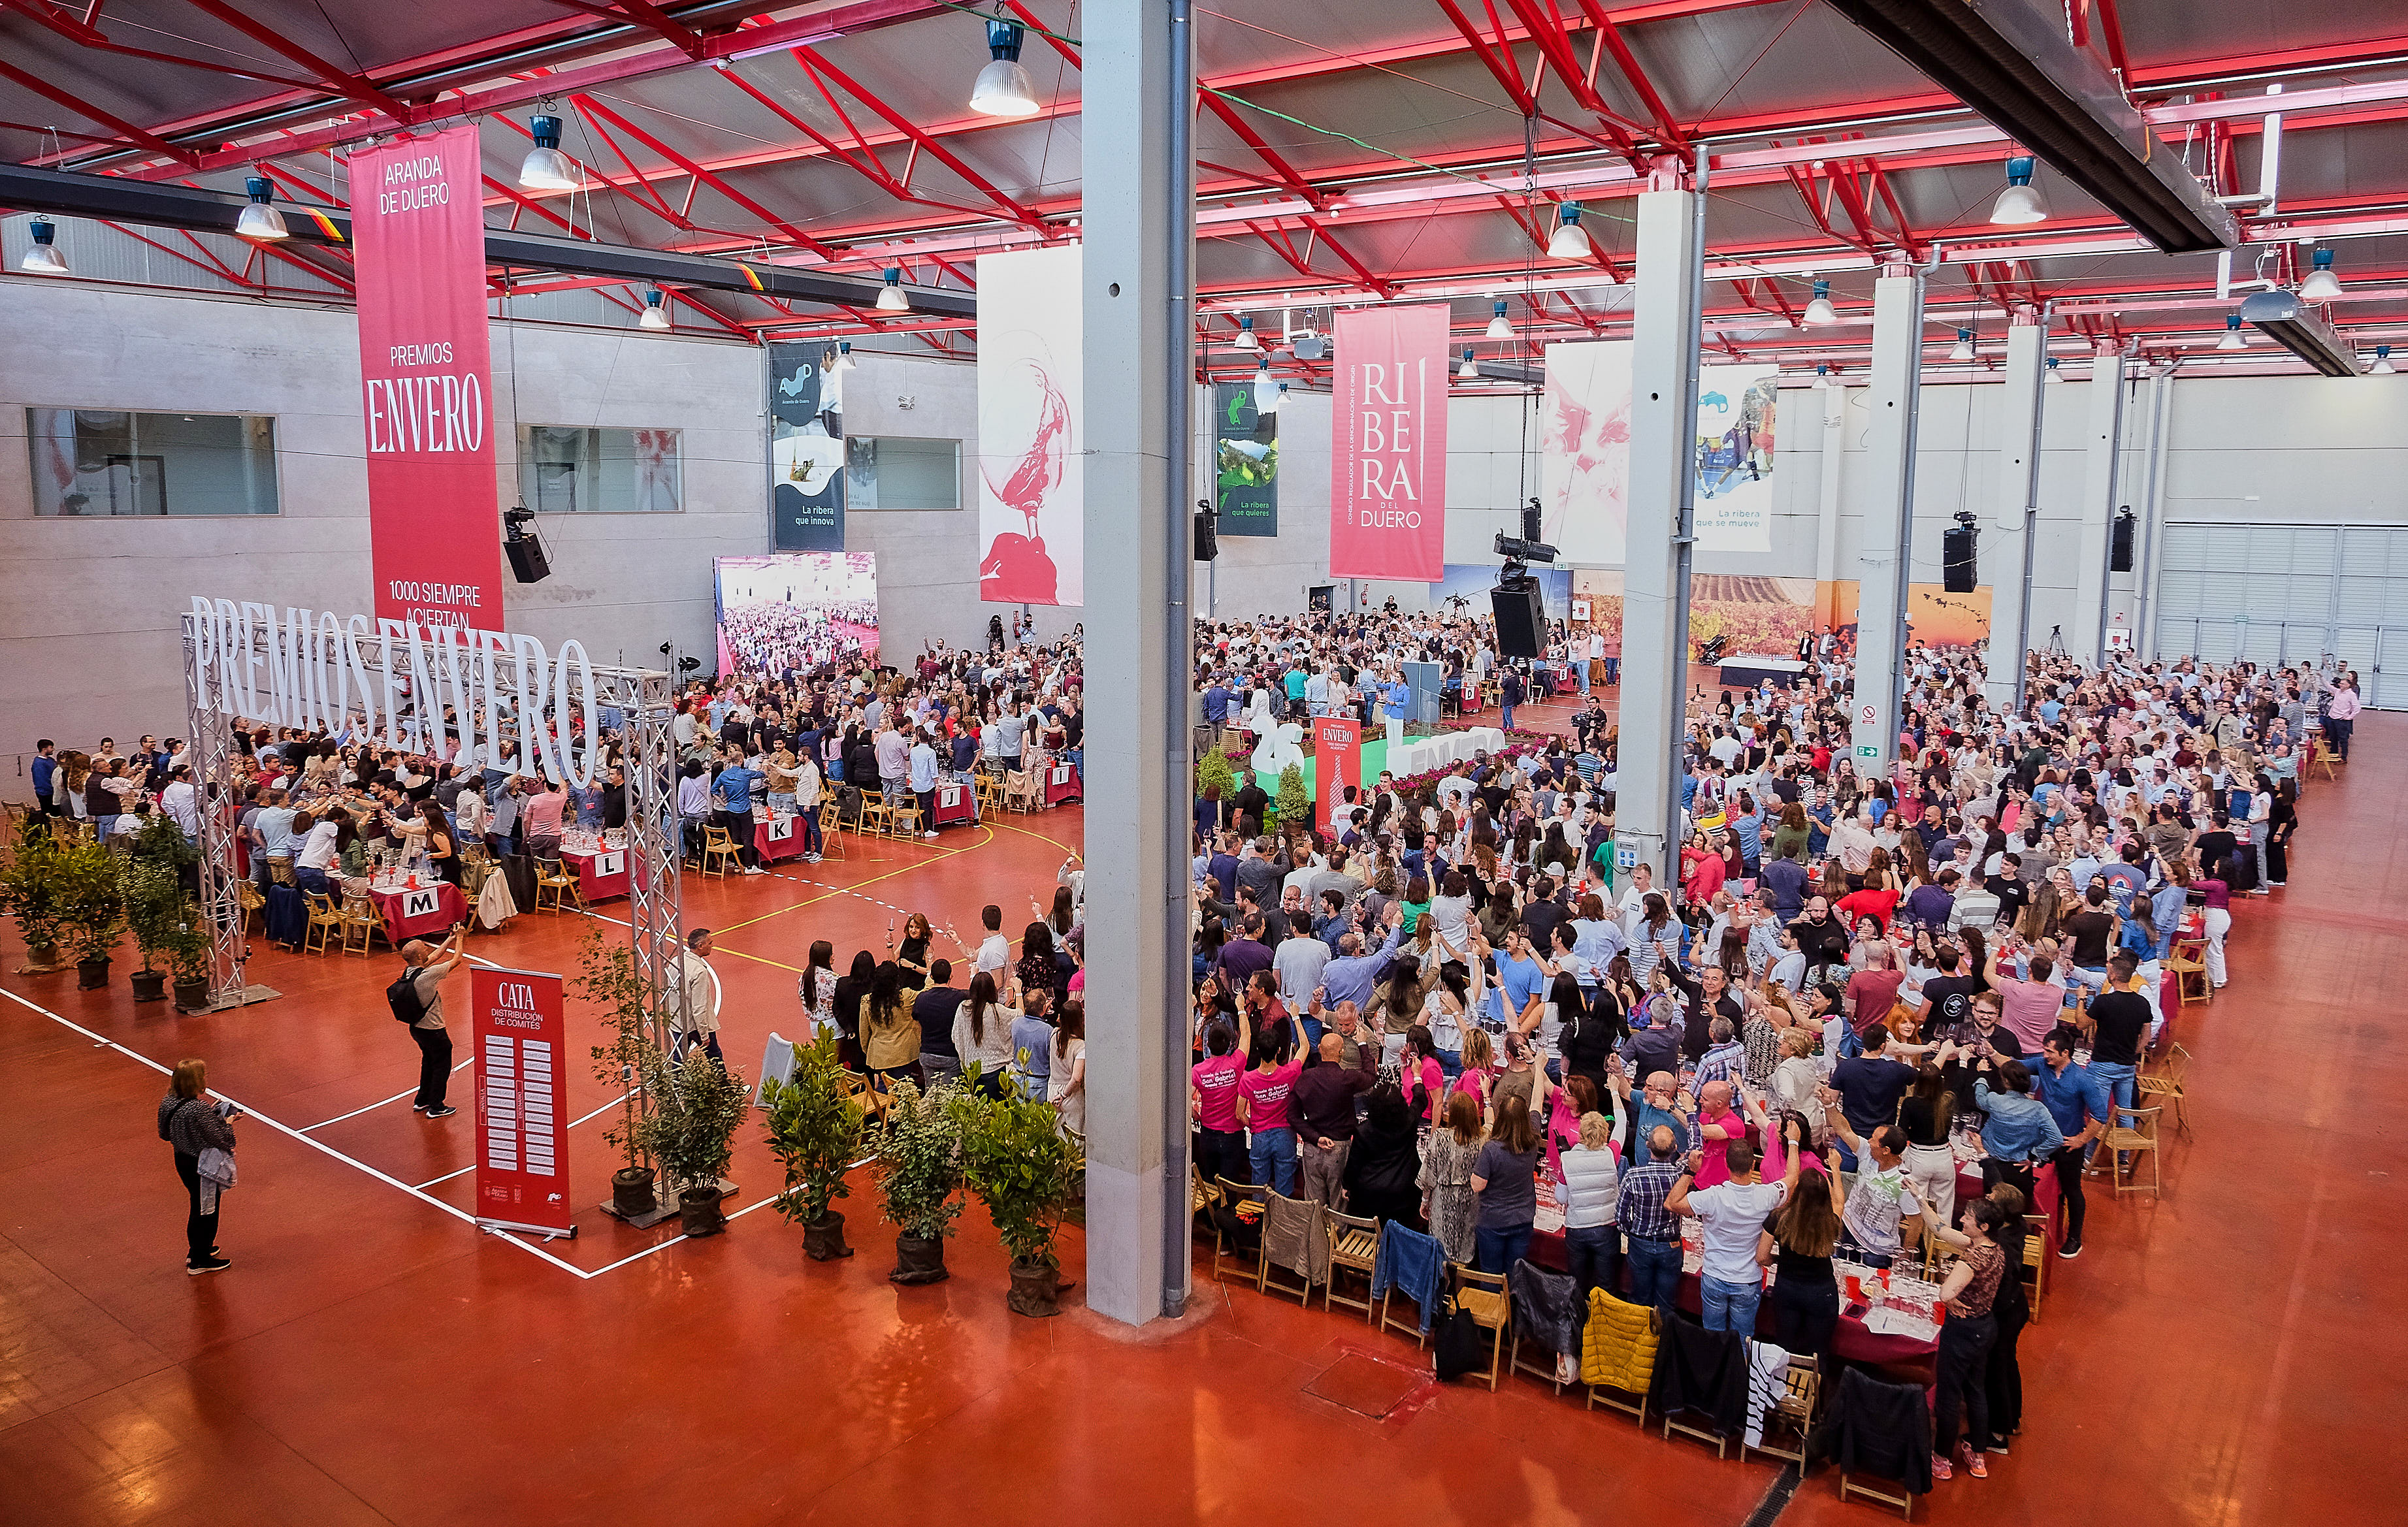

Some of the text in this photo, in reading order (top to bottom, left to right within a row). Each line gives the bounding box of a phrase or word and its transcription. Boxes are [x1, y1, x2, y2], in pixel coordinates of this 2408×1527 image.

[384, 155, 442, 186] ARANDA
[380, 182, 449, 216] DE DUERO
[390, 342, 453, 367] PREMIOS
[1361, 362, 1407, 405] RI
[367, 372, 482, 453] ENVERO
[1361, 410, 1411, 453] BE
[1359, 458, 1418, 500] RA
[813, 506, 834, 515] ribera
[1246, 509, 1269, 517] quieres
[1732, 509, 1760, 518] ribera
[795, 516, 834, 526] que innova
[1360, 509, 1422, 529] DUERO
[1696, 521, 1712, 529] que
[389, 580, 481, 607] 1000 SIEMPRE
[405, 607, 470, 632] ACIERTAN
[191, 595, 598, 788] PREMIOS ENVERO
[1467, 689, 1472, 699] D
[1323, 728, 1352, 743] ENVERO
[947, 791, 956, 807] J
[773, 823, 786, 839] K
[604, 858, 614, 874] L
[410, 893, 433, 915] M
[498, 982, 534, 1010] CATA
[491, 1008, 544, 1023] DISTRIBUCIÓN
[495, 1017, 541, 1031] DE COMITÉS
[1214, 1071, 1236, 1082] Gabriel
[1268, 1085, 1290, 1097] Gabriel
